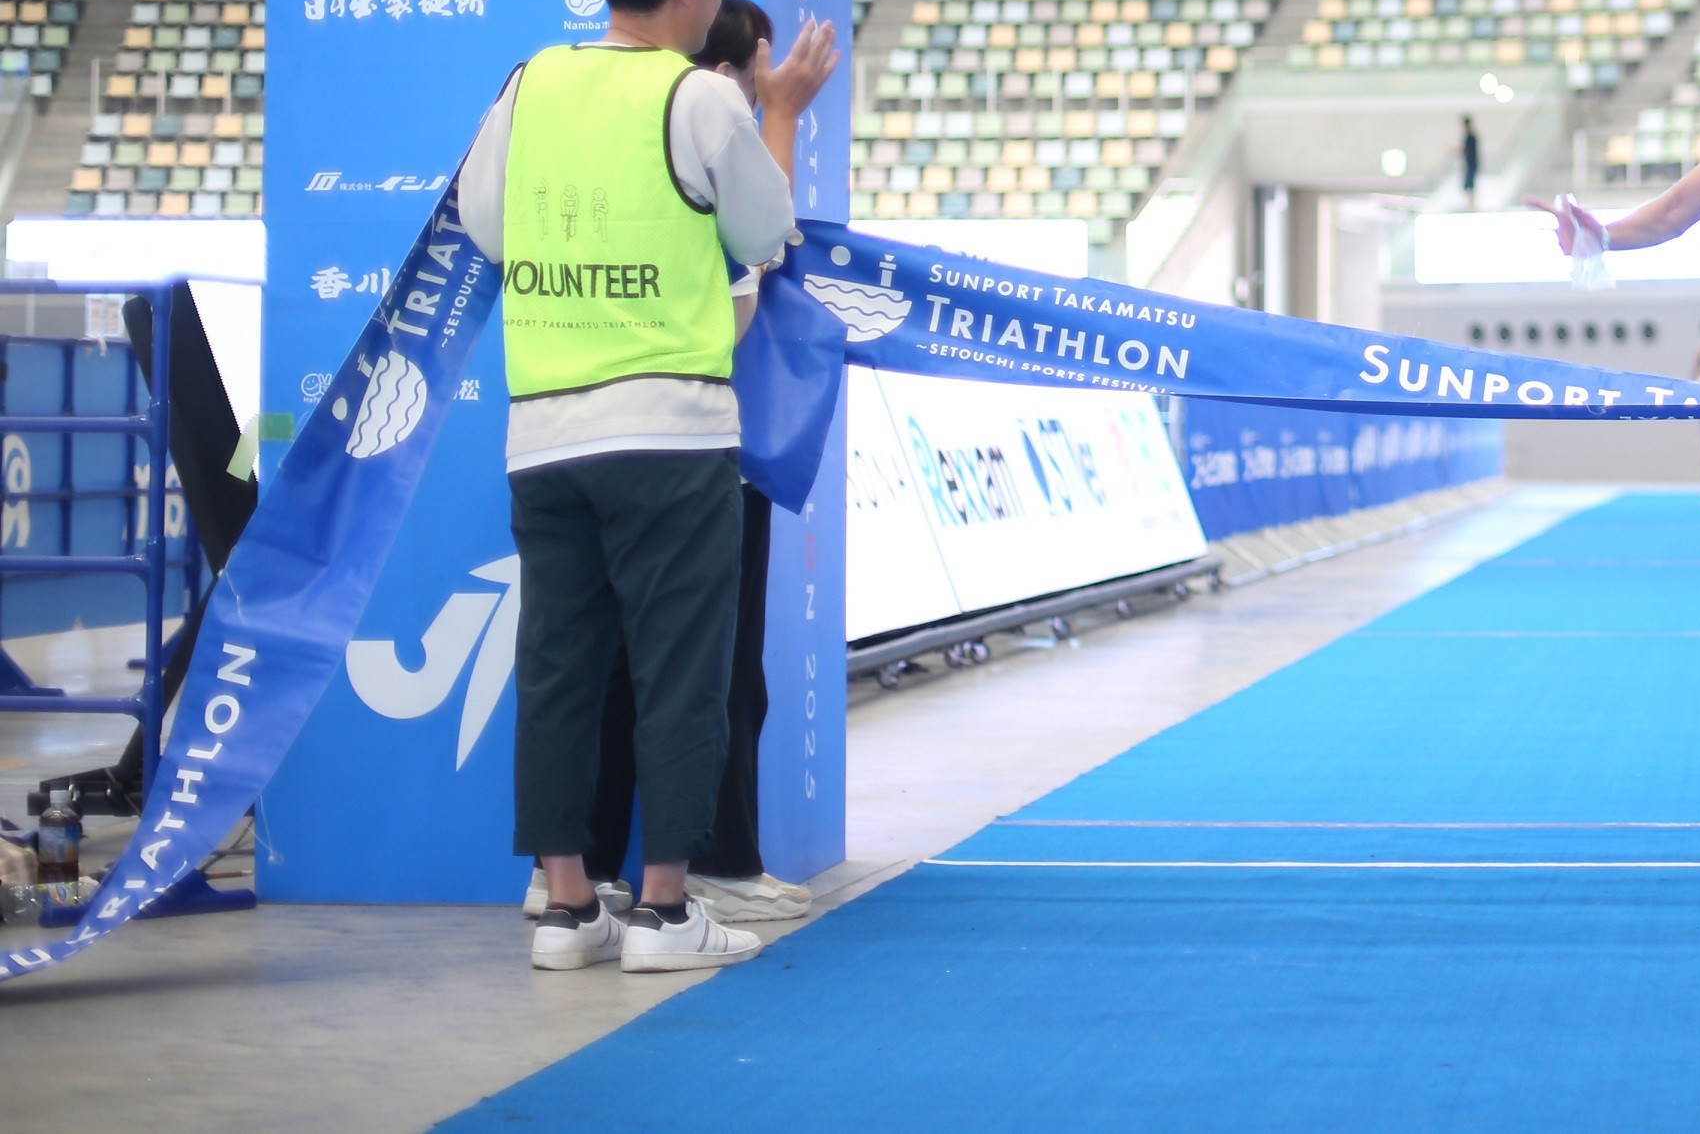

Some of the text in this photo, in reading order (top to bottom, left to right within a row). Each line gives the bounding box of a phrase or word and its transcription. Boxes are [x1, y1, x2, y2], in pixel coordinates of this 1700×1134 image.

[542, 320, 599, 330] TAKAMATSU
[602, 320, 666, 330] TRIATHLON
[928, 262, 1197, 330] SUNPORT TAKAMATSU
[925, 293, 1190, 380] TRIATHLON
[1020, 361, 1086, 383] SPORTS
[1359, 344, 1622, 407] SUNPORT
[908, 414, 1027, 527] Rexxam
[804, 653, 816, 801] 2025
